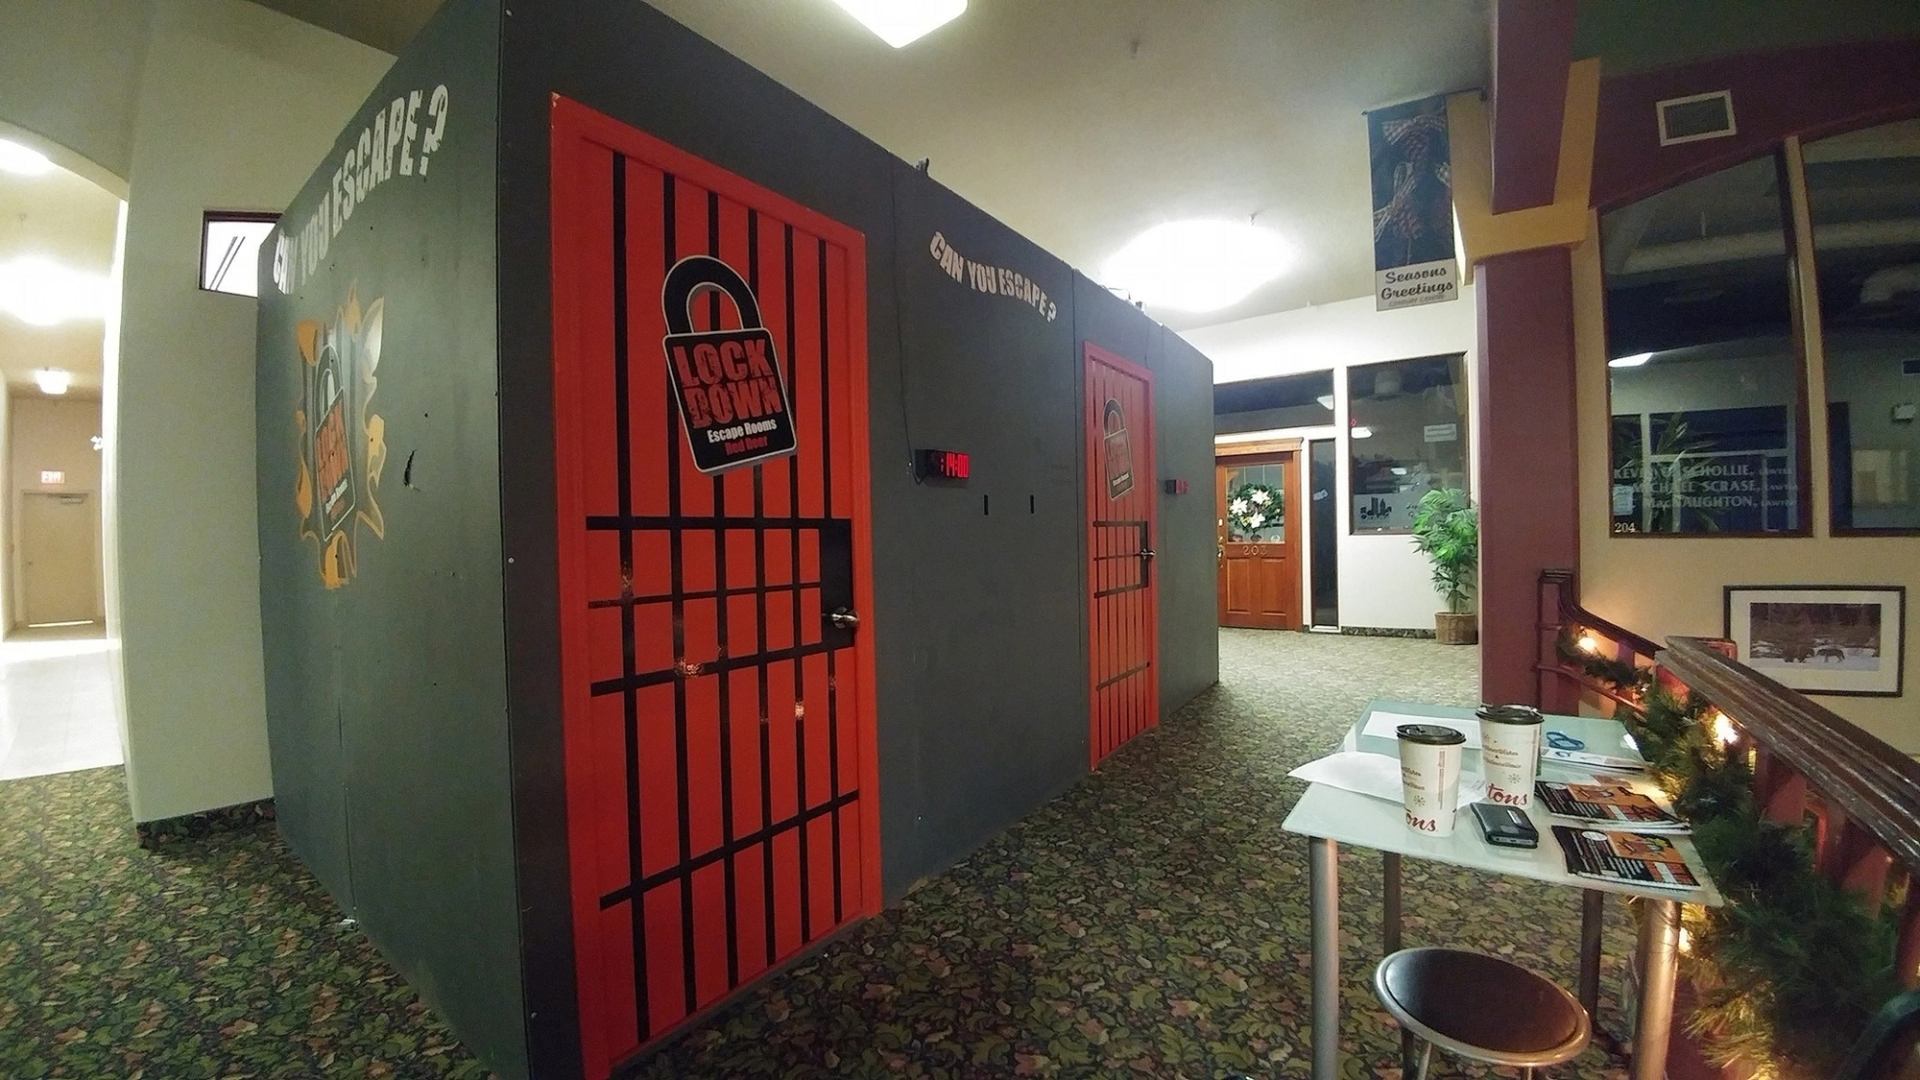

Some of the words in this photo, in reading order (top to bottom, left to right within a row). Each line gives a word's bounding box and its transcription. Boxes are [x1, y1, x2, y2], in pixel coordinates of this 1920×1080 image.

[929, 231, 964, 284] CAN
[967, 260, 997, 294] YOU
[1385, 267, 1447, 284] Seasons
[1381, 282, 1453, 300] Greetings
[672, 338, 775, 387] LOCK
[684, 376, 783, 429] DOWN
[707, 425, 745, 444] Escape
[743, 418, 778, 436] Rooms
[1614, 522, 1636, 533] 204
